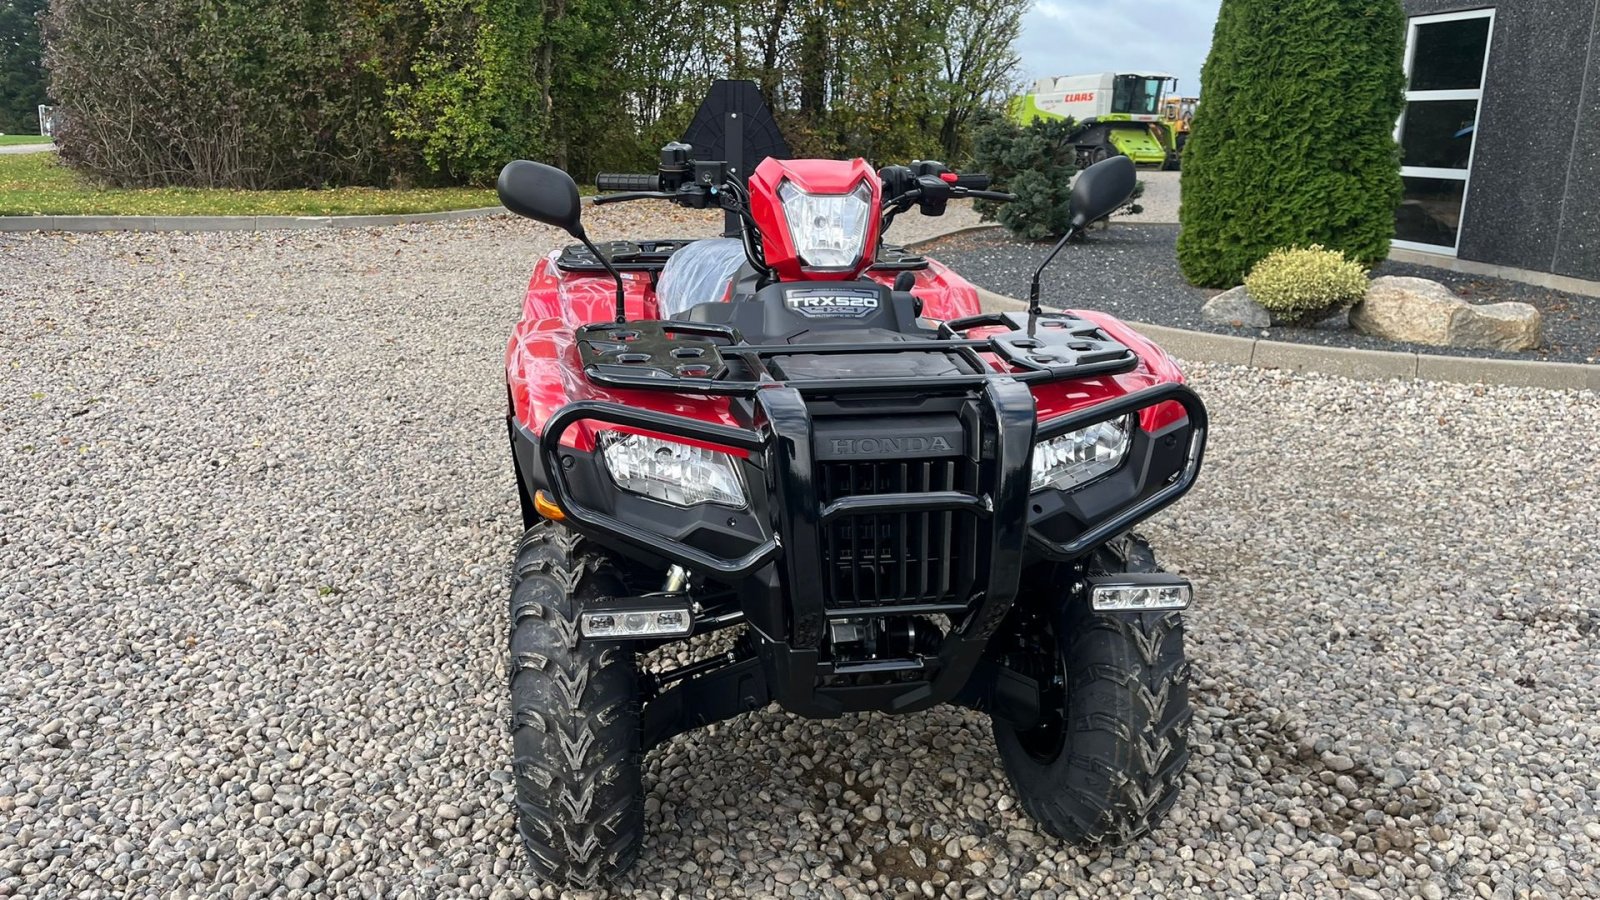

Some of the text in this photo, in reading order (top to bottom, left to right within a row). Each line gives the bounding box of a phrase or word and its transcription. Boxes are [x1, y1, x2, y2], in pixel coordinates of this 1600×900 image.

[1064, 92, 1094, 103] CLAAS
[787, 296, 878, 308] TRX520
[830, 436, 953, 455] HONDA
